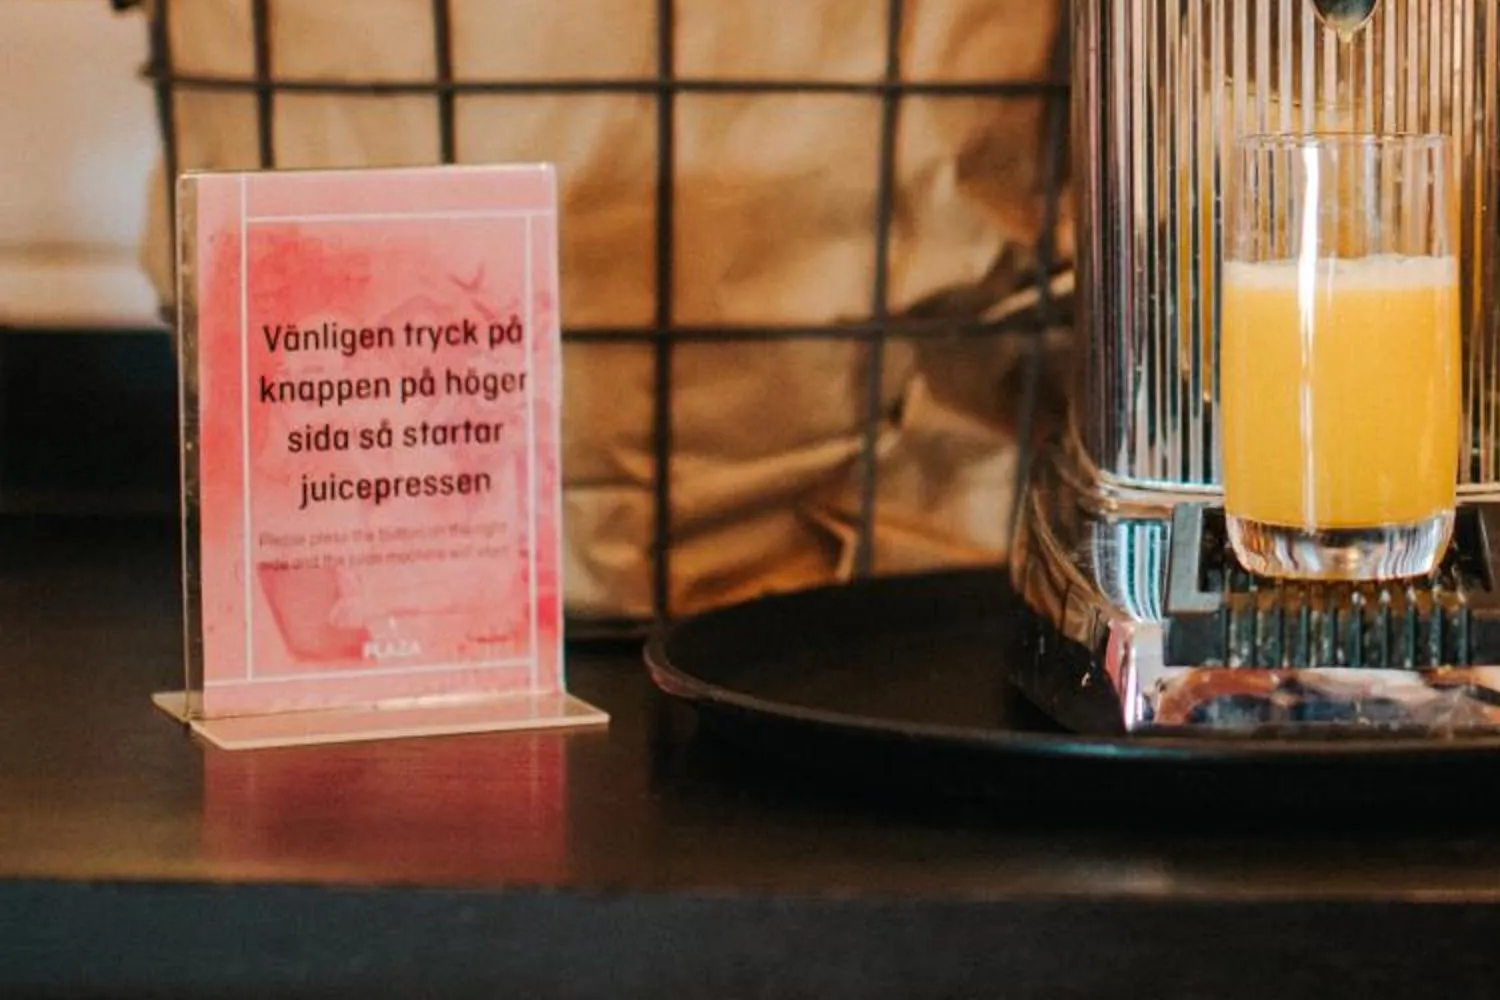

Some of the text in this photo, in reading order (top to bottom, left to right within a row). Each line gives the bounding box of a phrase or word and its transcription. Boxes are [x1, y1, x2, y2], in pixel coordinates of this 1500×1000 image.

[263, 315, 524, 357] Vänligen tryck på
[259, 367, 528, 407] knappen på höger
[288, 418, 504, 453] sida så startar
[299, 471, 492, 510] juicepressen
